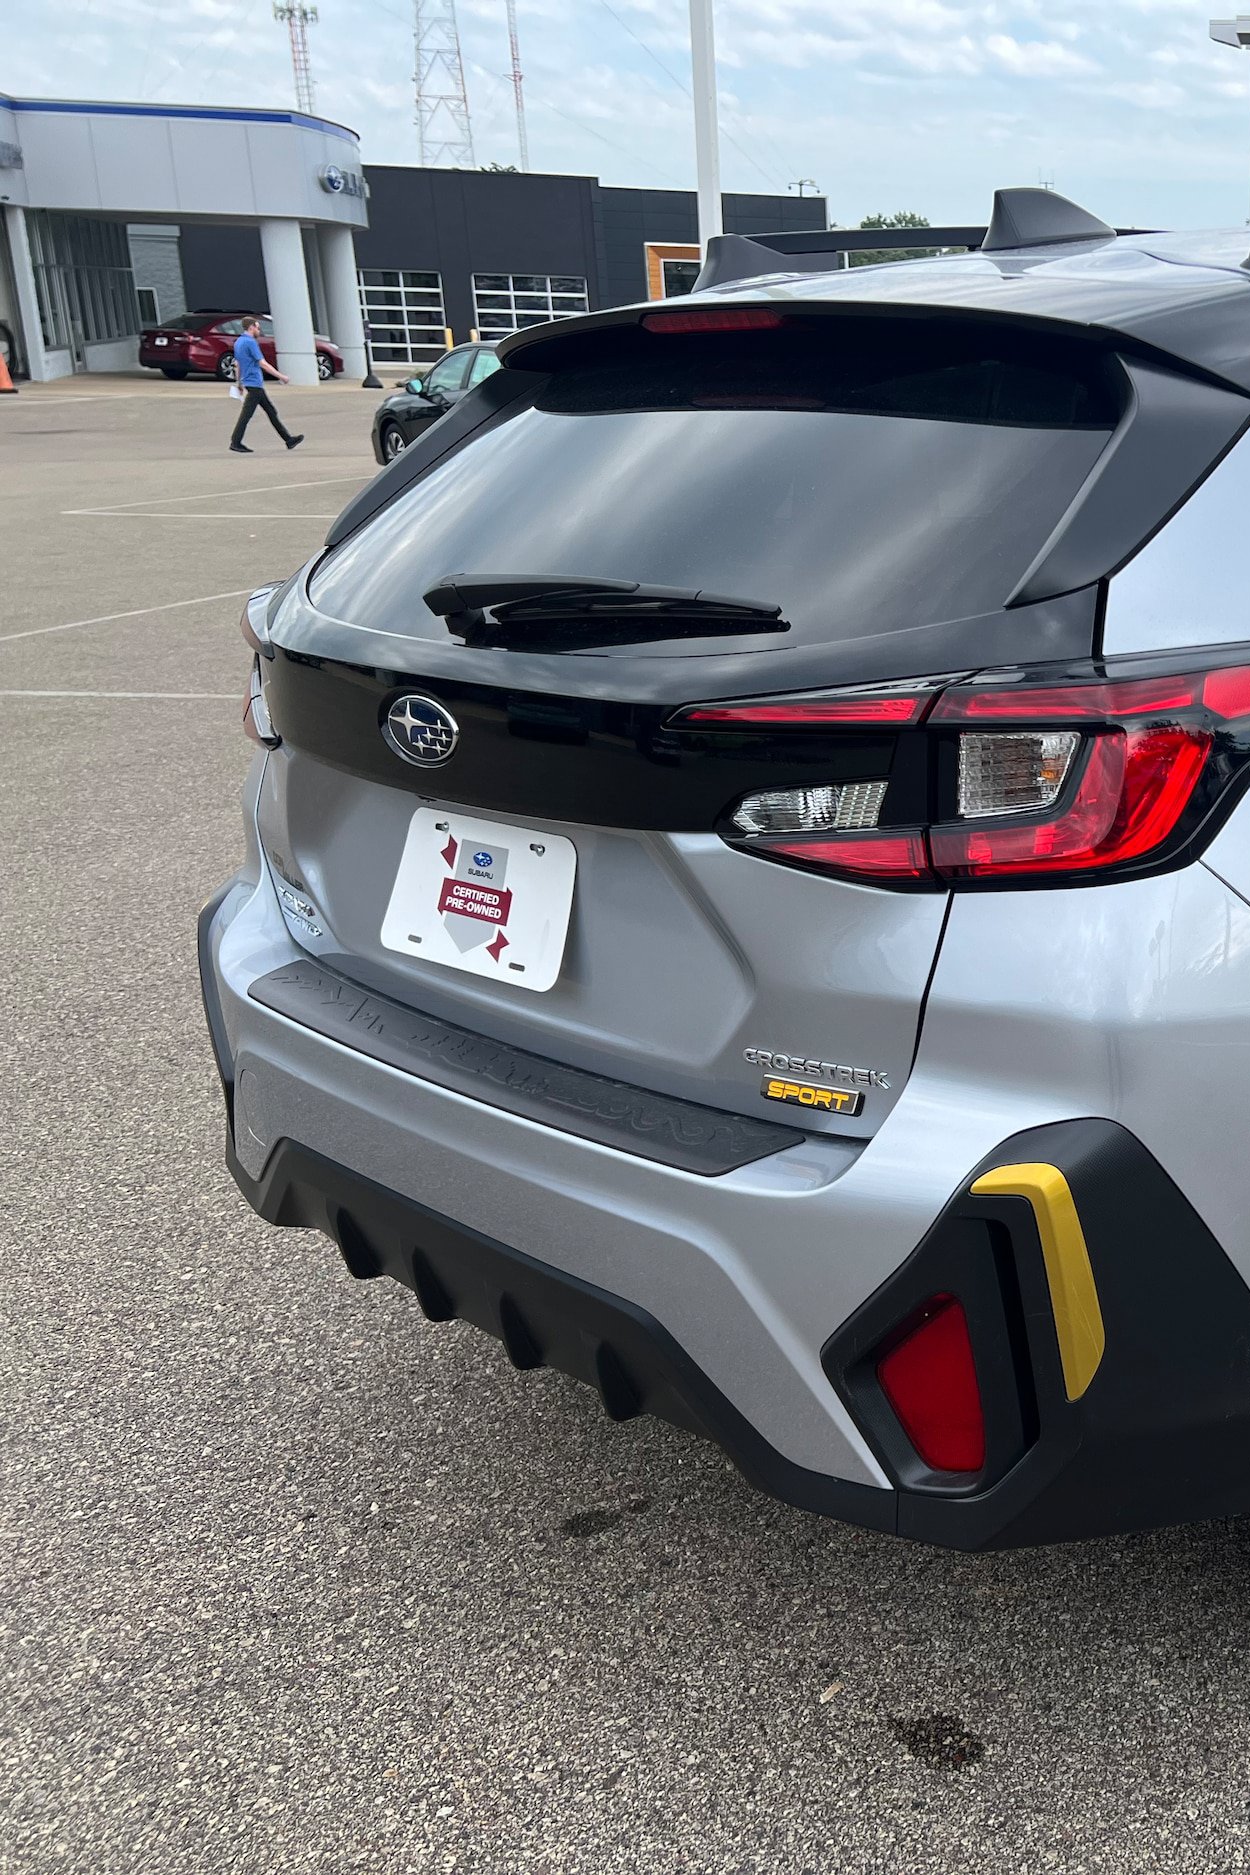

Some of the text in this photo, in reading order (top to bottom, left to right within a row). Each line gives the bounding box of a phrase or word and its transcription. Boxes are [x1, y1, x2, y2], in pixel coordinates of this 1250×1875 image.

[467, 868, 494, 880] SUBARU
[452, 885, 500, 906] CERTIFIED
[445, 896, 502, 919] PRE-OWNED
[743, 1047, 892, 1090] CROSSTREK
[766, 1081, 850, 1110] SPORT
